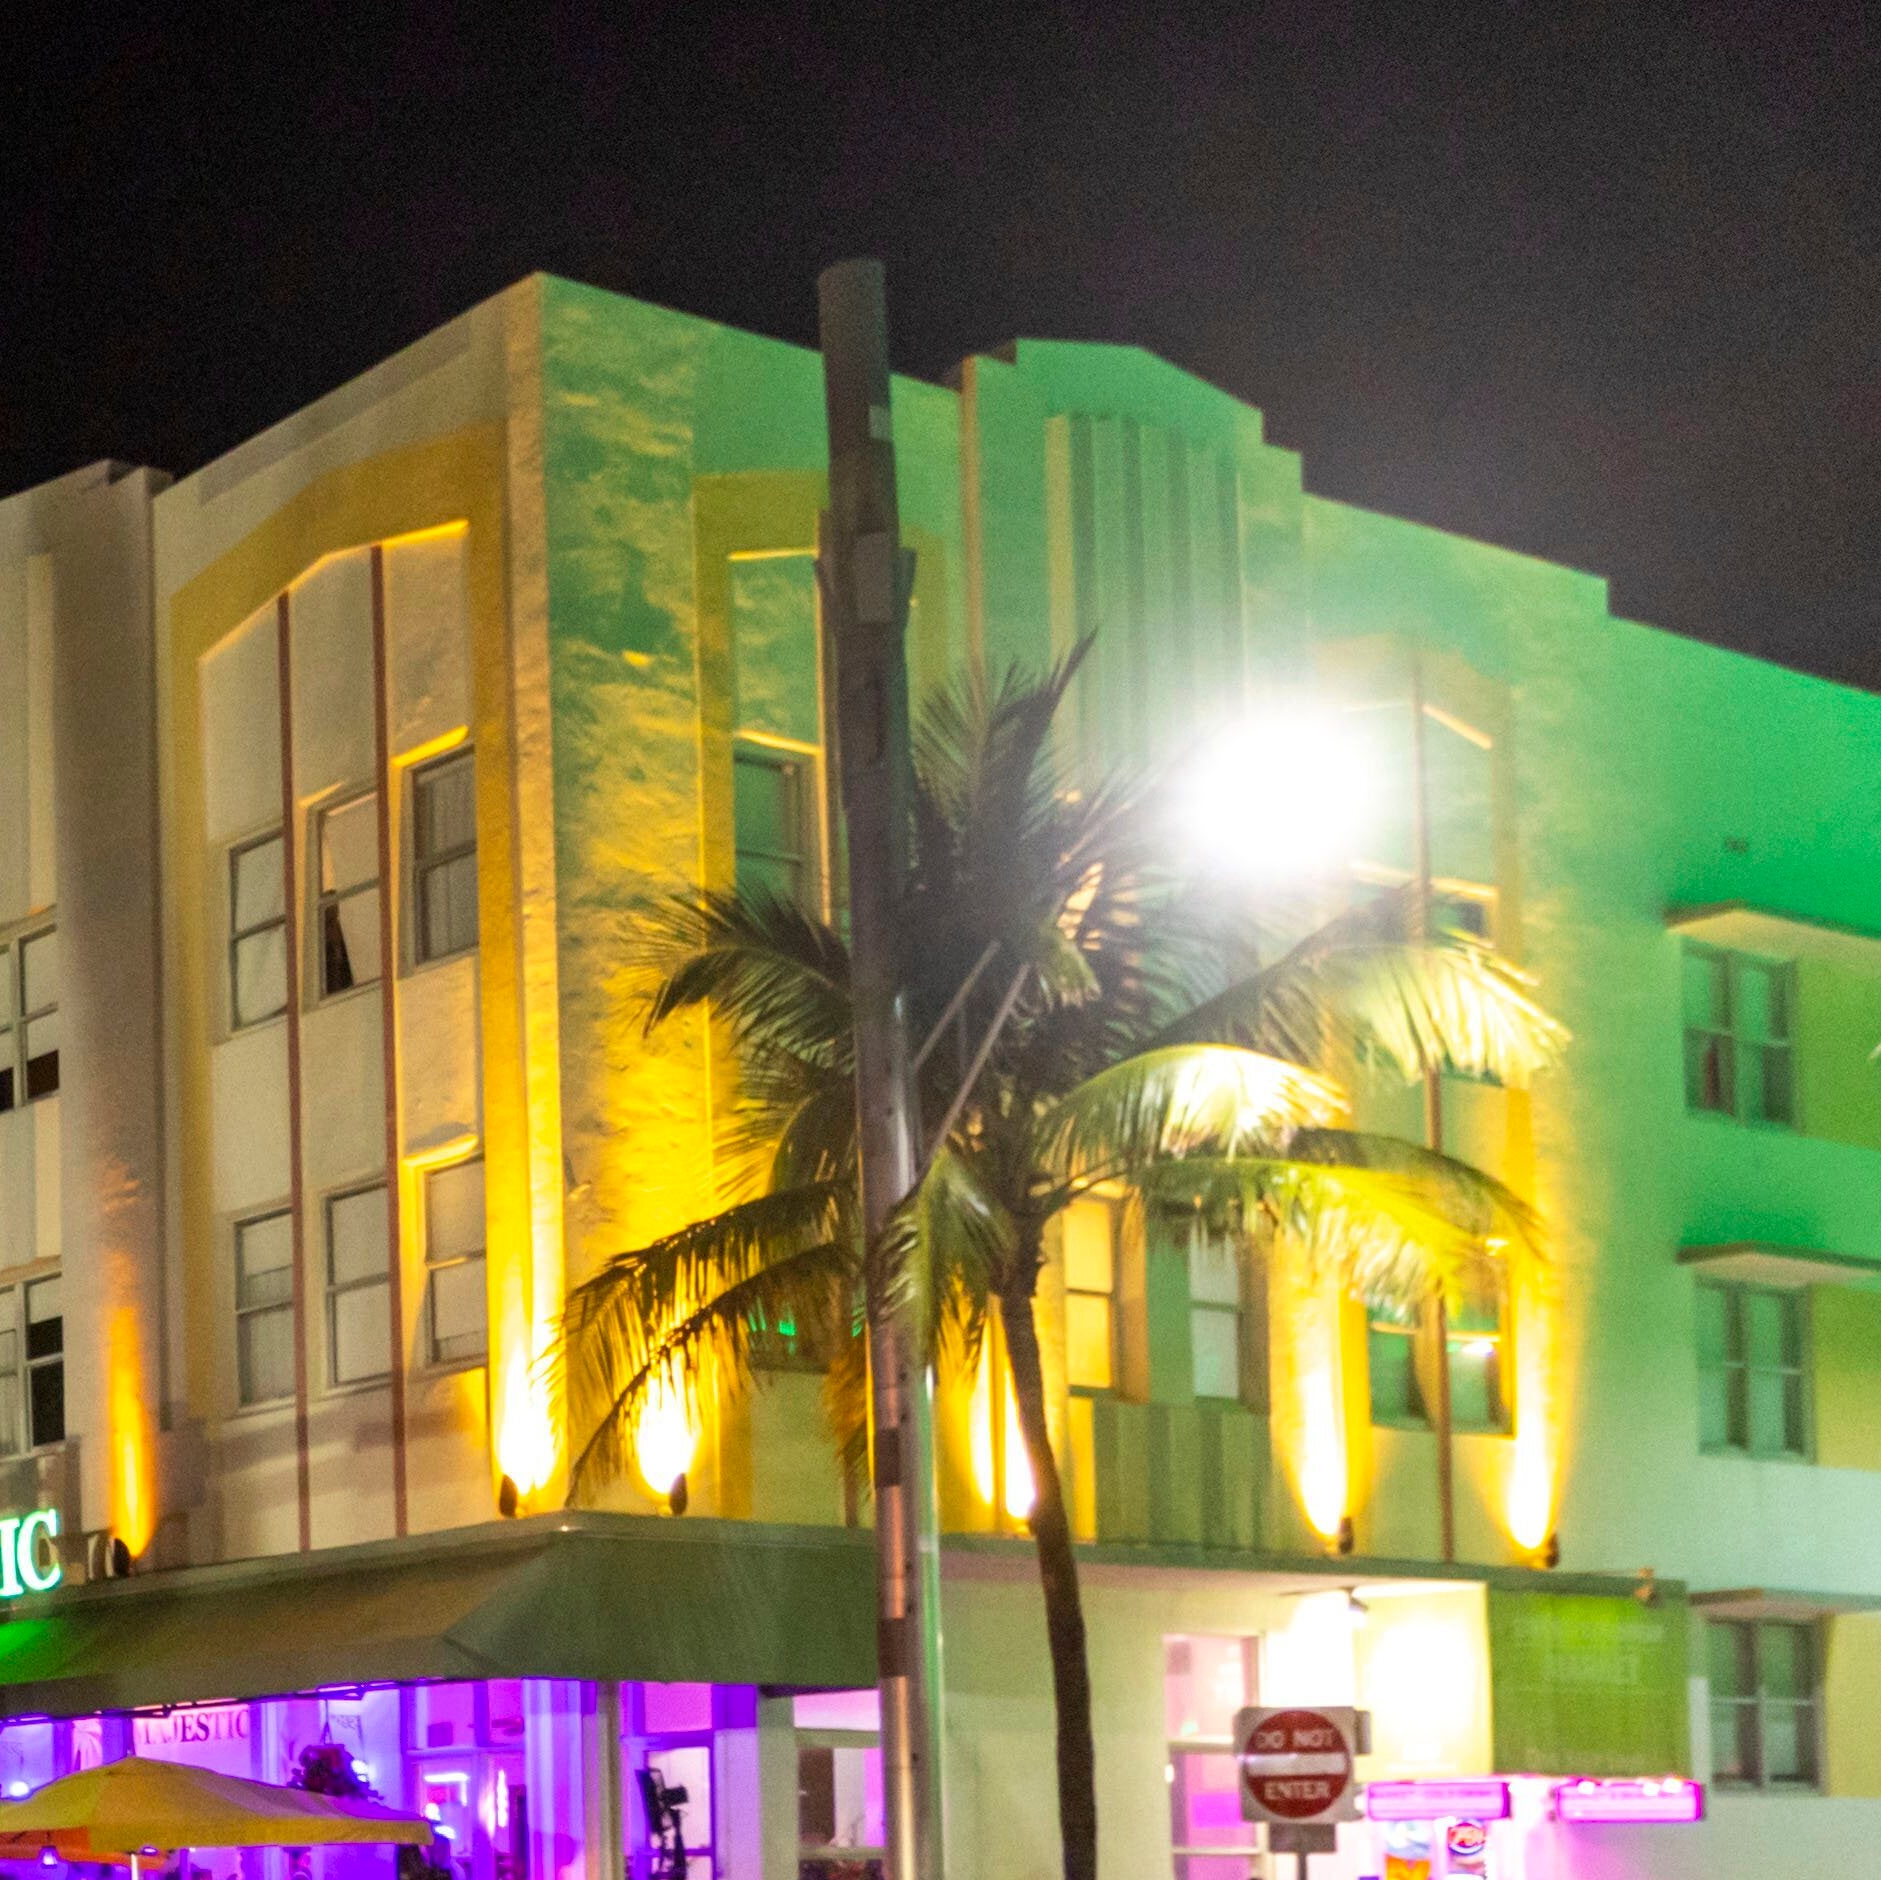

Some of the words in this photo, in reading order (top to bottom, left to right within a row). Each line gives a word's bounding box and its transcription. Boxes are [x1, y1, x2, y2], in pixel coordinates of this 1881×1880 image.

[1255, 1730, 1284, 1749] DO
[1293, 1729, 1335, 1747] NOT
[1264, 1781, 1330, 1800] ENTER
